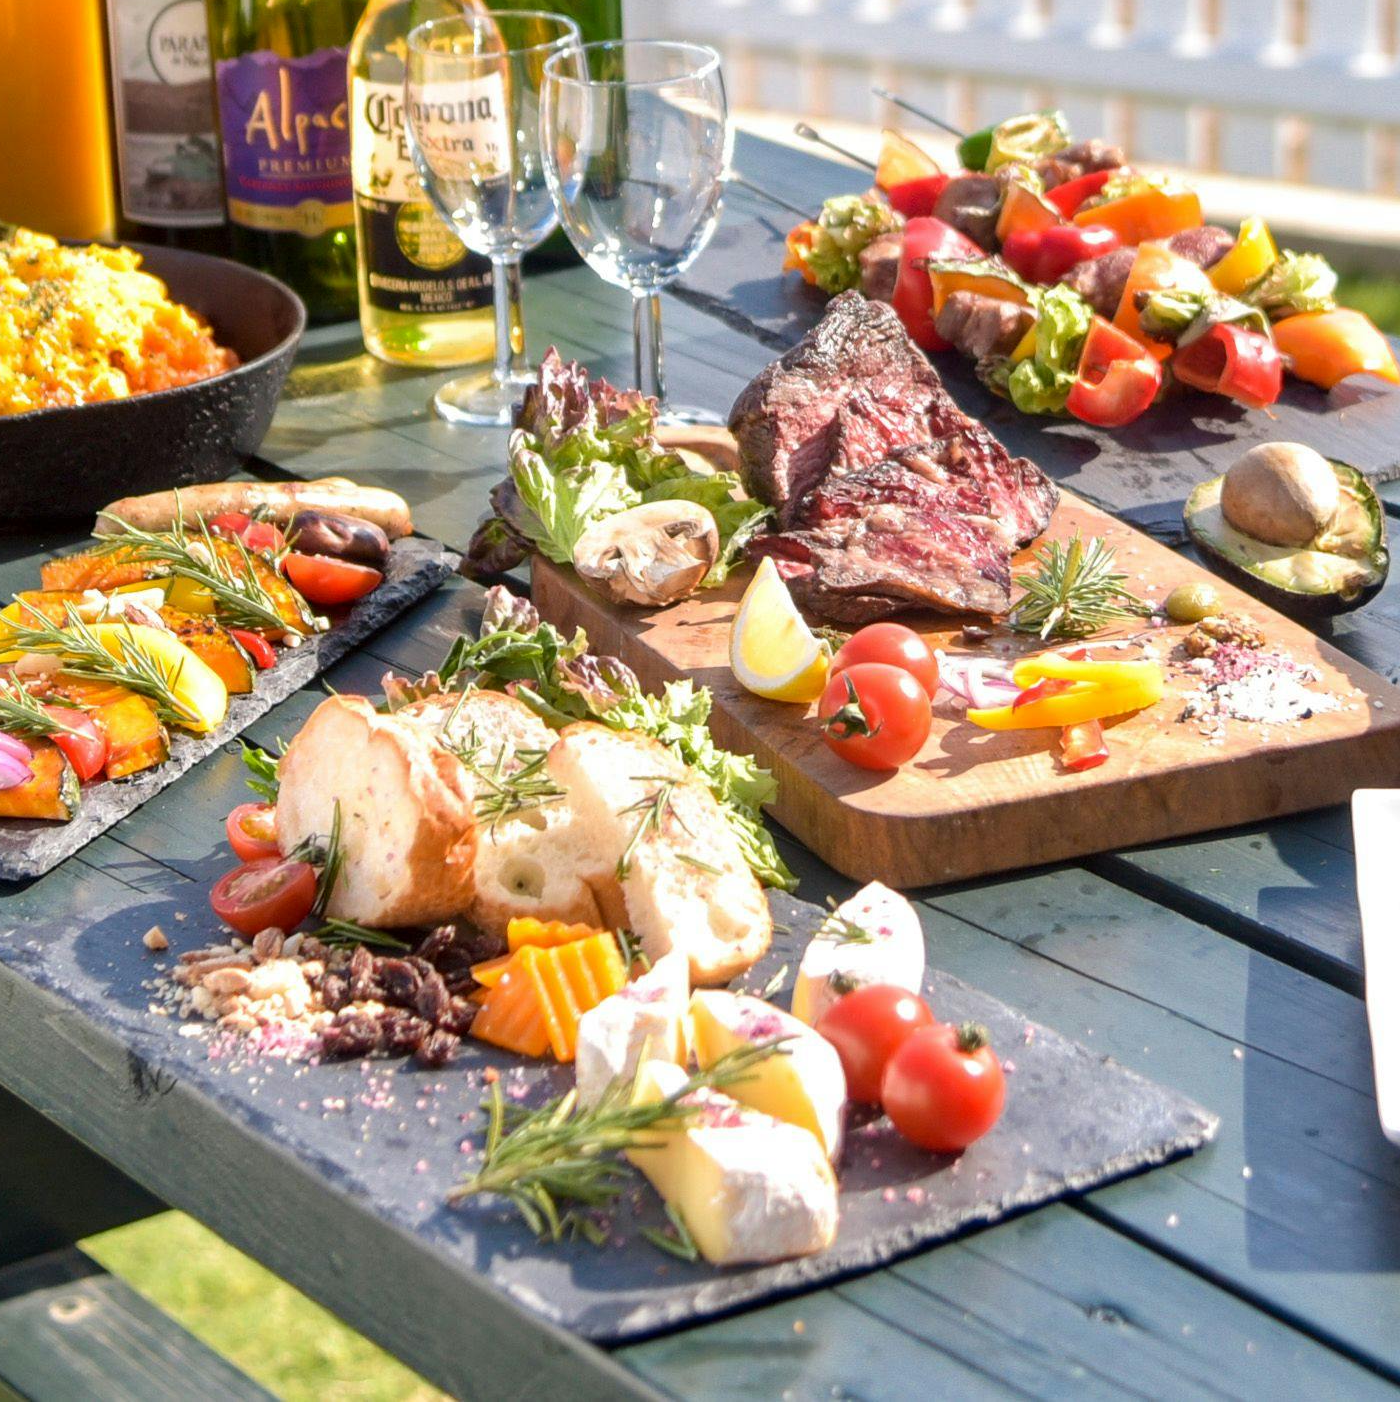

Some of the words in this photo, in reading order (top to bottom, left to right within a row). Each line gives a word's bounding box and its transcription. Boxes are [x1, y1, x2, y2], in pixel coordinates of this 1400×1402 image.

[246, 67, 348, 156] Alpac
[365, 92, 492, 141] Corona
[397, 129, 475, 163] Extra
